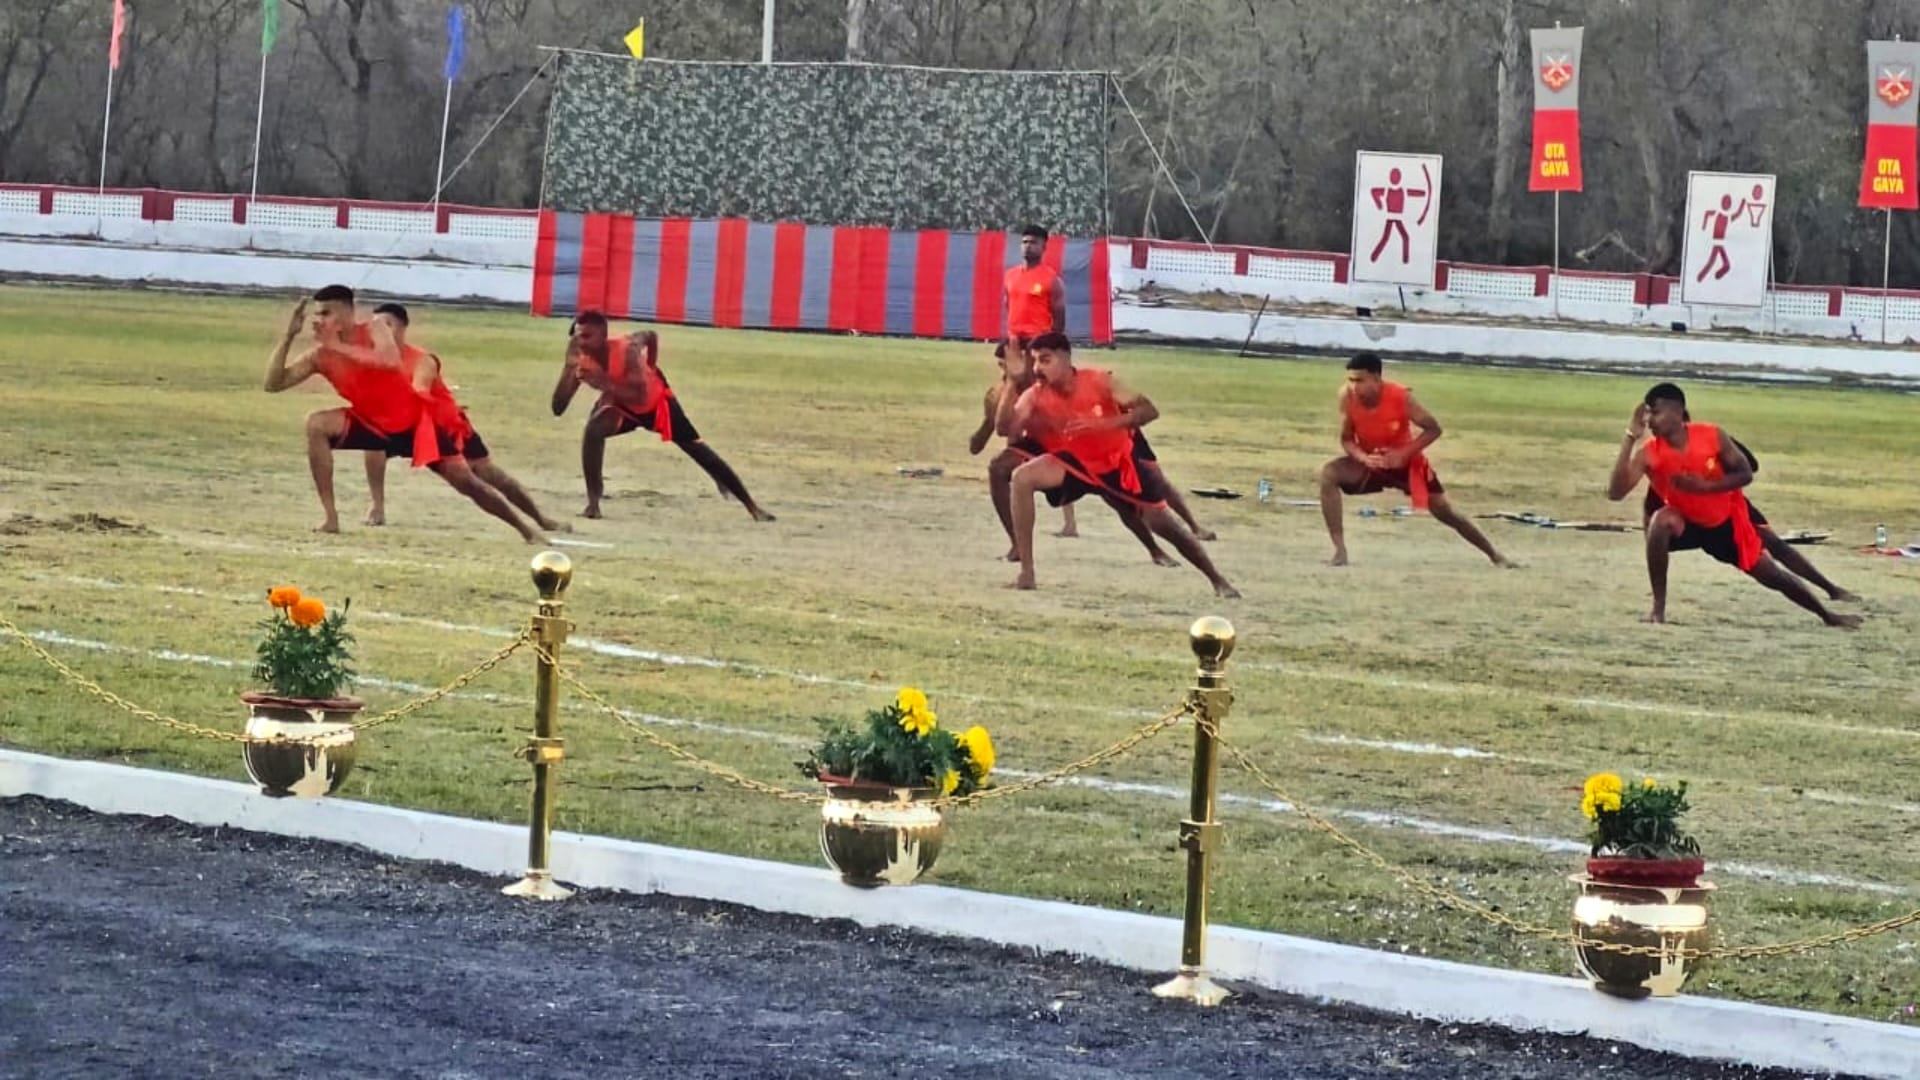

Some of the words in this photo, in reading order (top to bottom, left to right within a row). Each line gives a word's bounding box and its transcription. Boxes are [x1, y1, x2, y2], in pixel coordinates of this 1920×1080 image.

[1544, 142, 1566, 159] OTA
[1540, 160, 1569, 177] GAYA
[1878, 158, 1901, 175] OTA
[1872, 177, 1904, 194] GAYA
